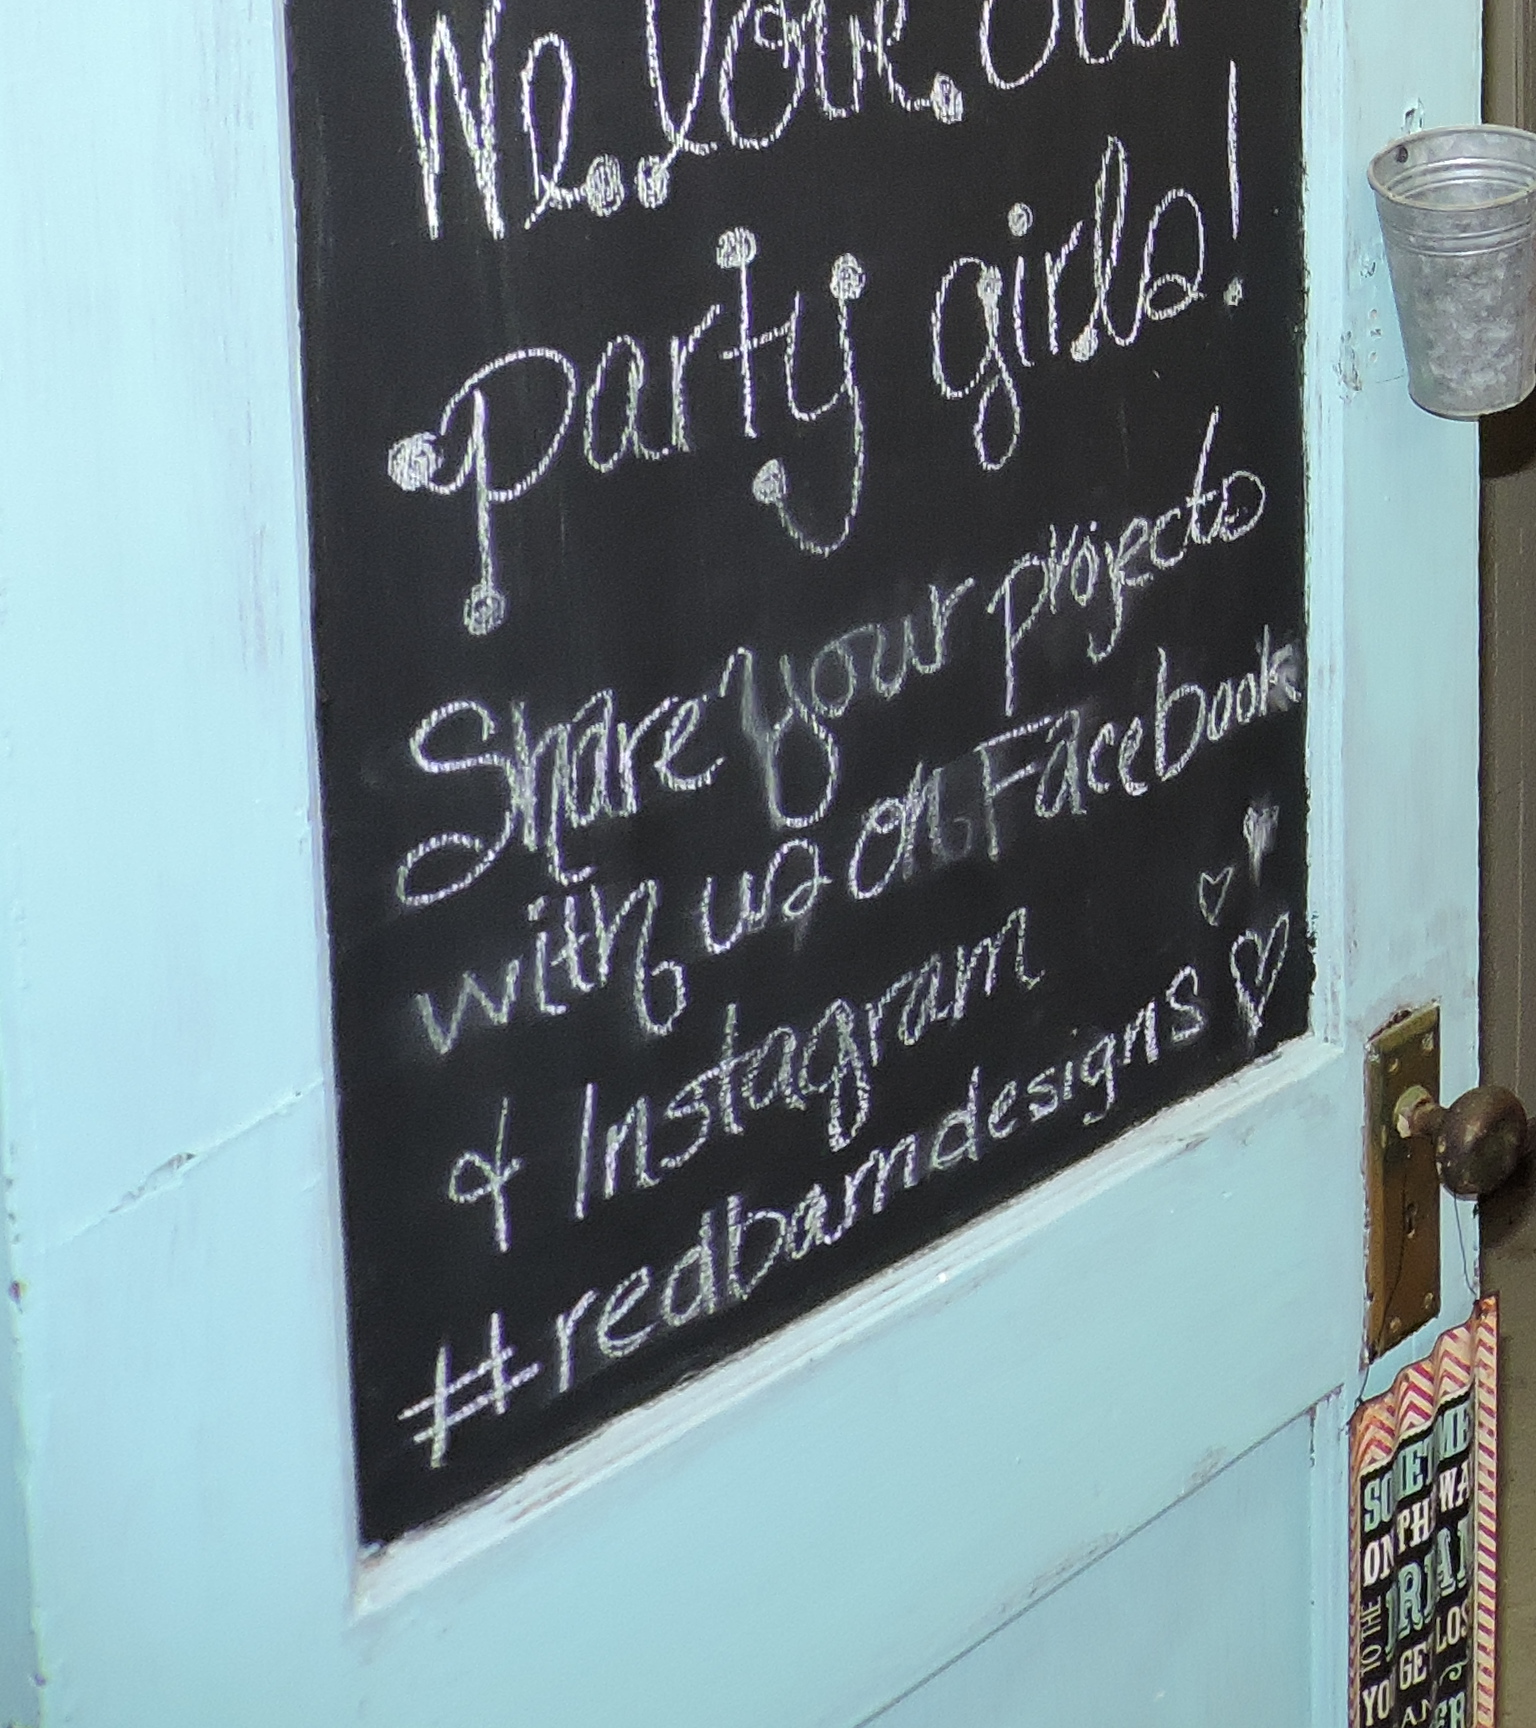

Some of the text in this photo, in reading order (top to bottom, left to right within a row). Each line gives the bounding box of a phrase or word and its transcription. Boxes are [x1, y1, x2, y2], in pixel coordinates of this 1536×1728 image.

[388, 225, 869, 635] party
[398, 688, 724, 907] Share
[720, 576, 976, 832] your
[411, 876, 688, 1056] with
[979, 622, 1303, 862] Facebook
[397, 963, 1206, 1469] #redbarndesigns
[571, 906, 1046, 1222] Instagram
[1361, 1595, 1382, 1643] THE
[1363, 1530, 1396, 1587] ON
[1439, 1459, 1472, 1513] WA
[1436, 1596, 1470, 1655] LOS
